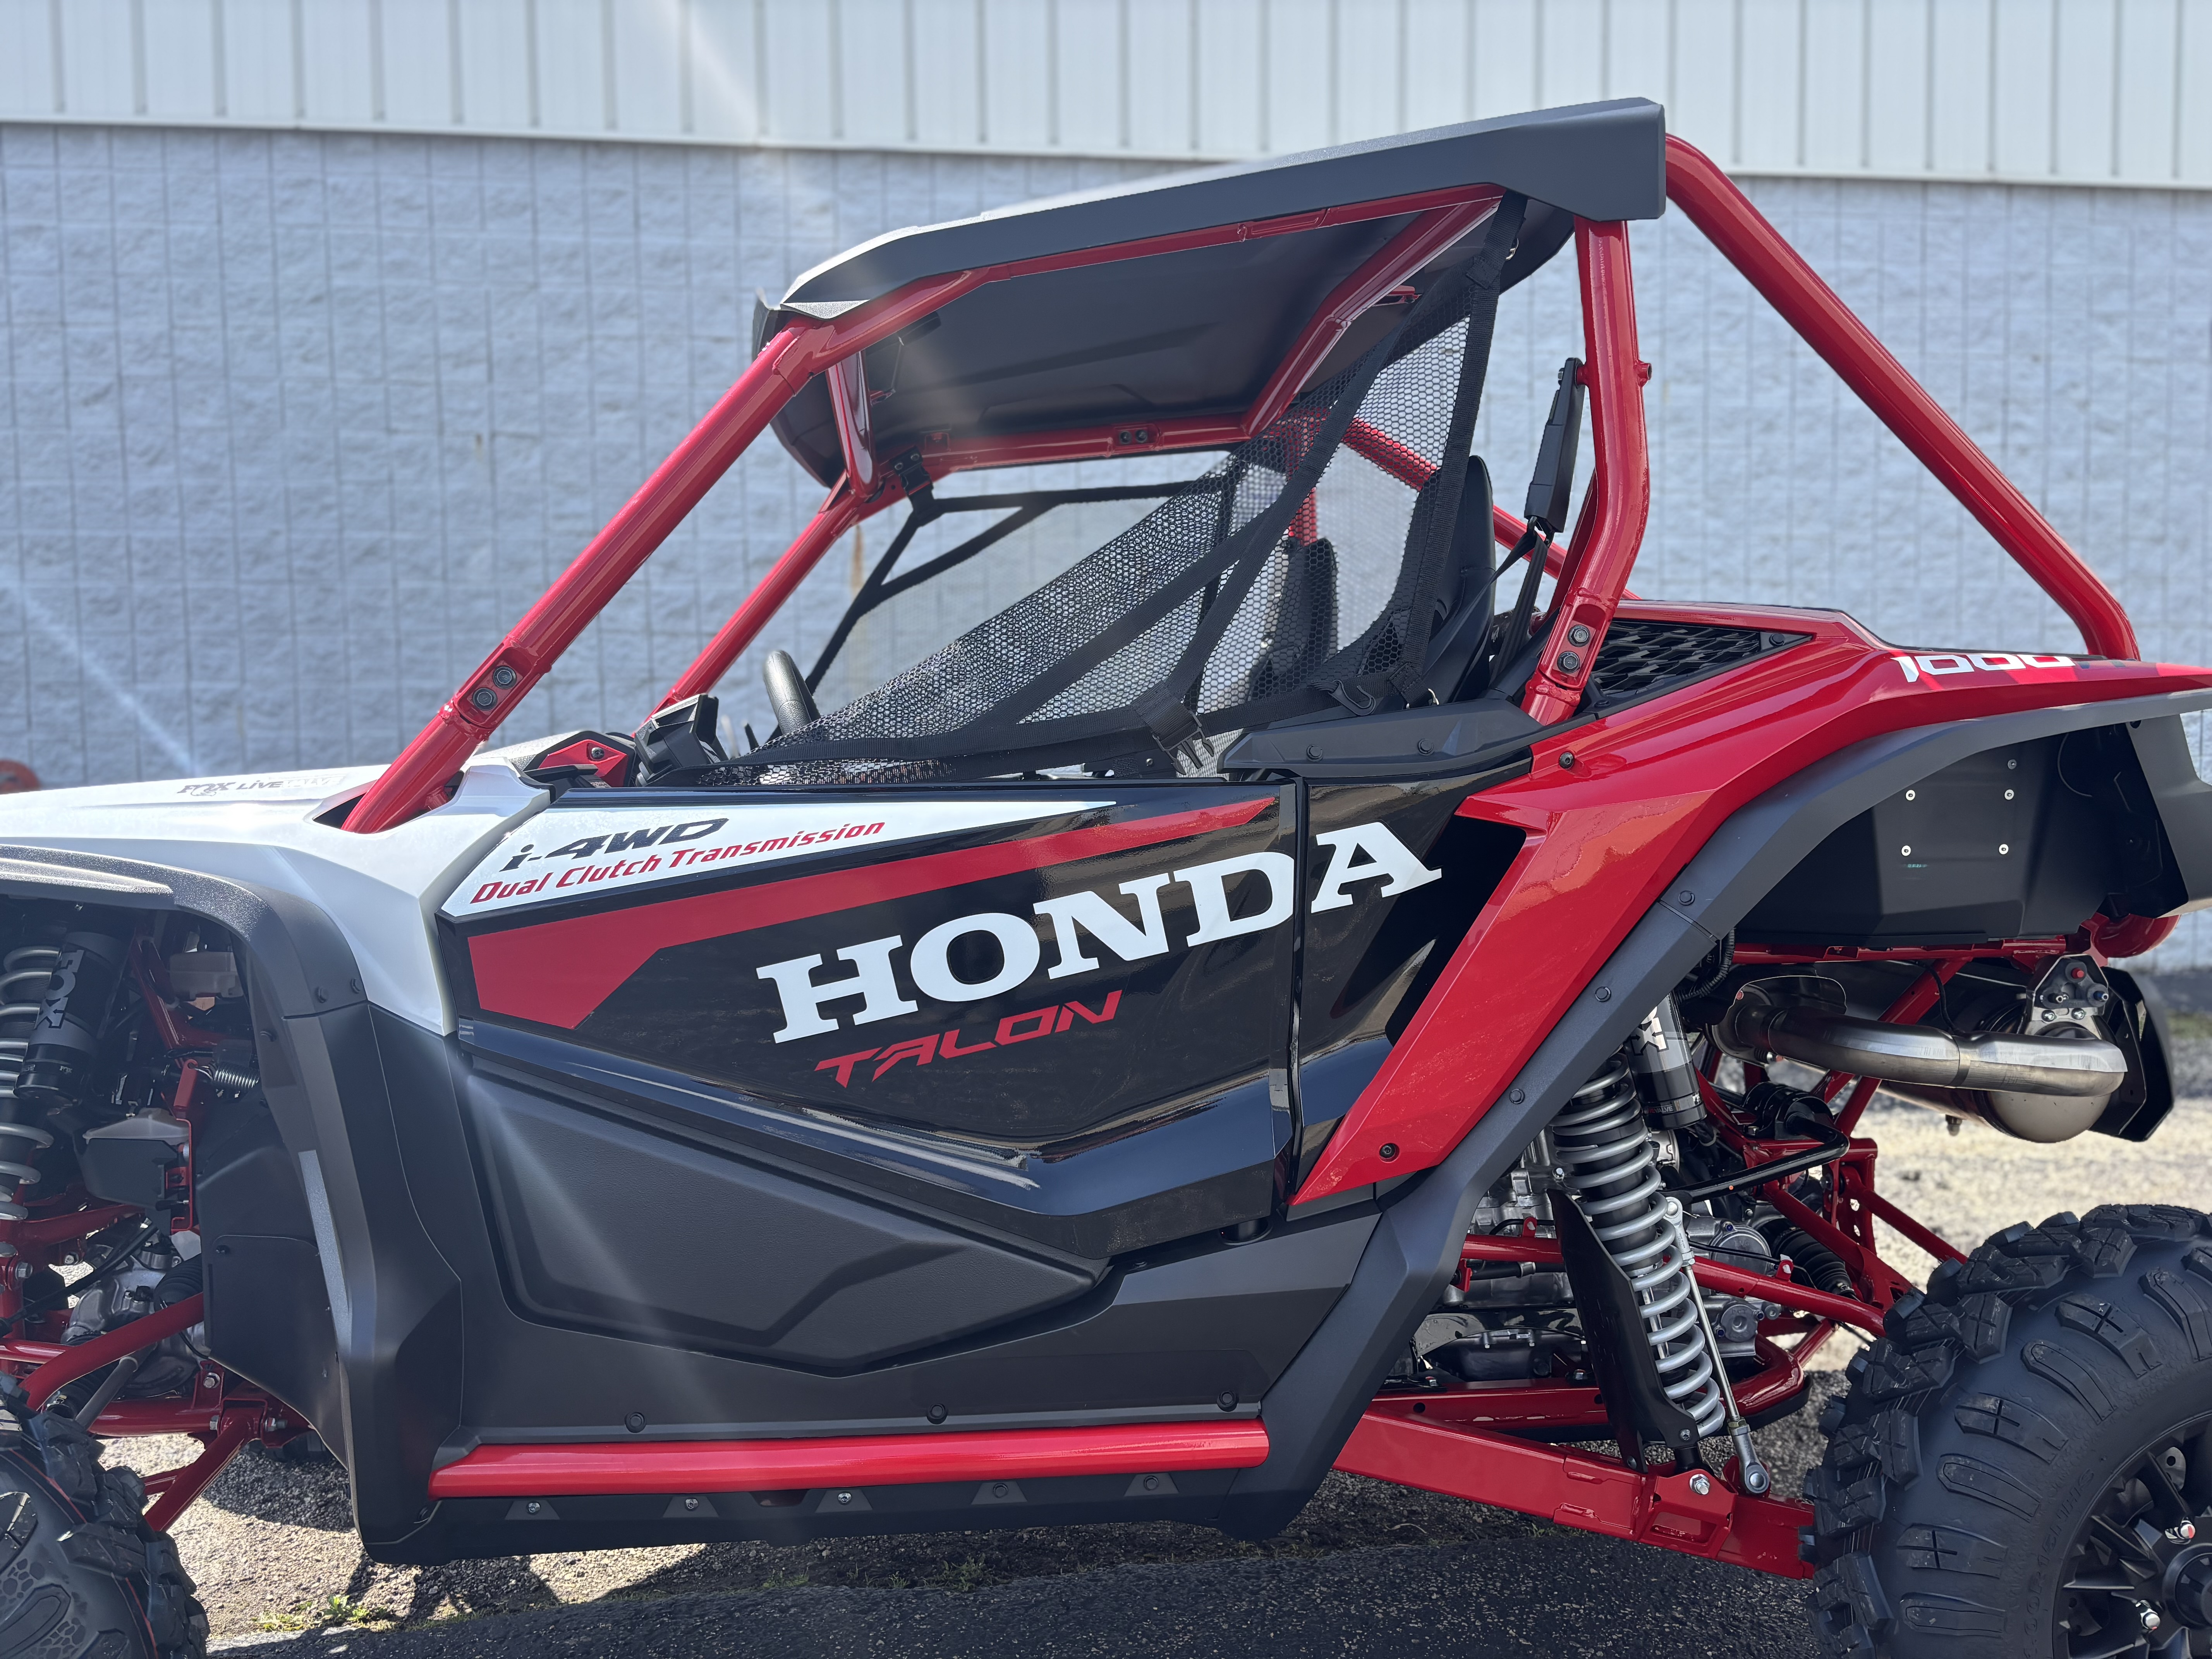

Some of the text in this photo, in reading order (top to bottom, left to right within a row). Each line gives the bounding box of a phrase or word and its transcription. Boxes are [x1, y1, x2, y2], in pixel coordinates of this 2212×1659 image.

[1890, 653, 2076, 683] 1000
[177, 781, 236, 796] FOX
[469, 822, 885, 903] Dual Clutch Transmission
[499, 817, 730, 872] i-4WD
[756, 821, 1442, 1044] HONDA
[34, 949, 84, 1027] FOX
[814, 990, 1123, 1088] TALON
